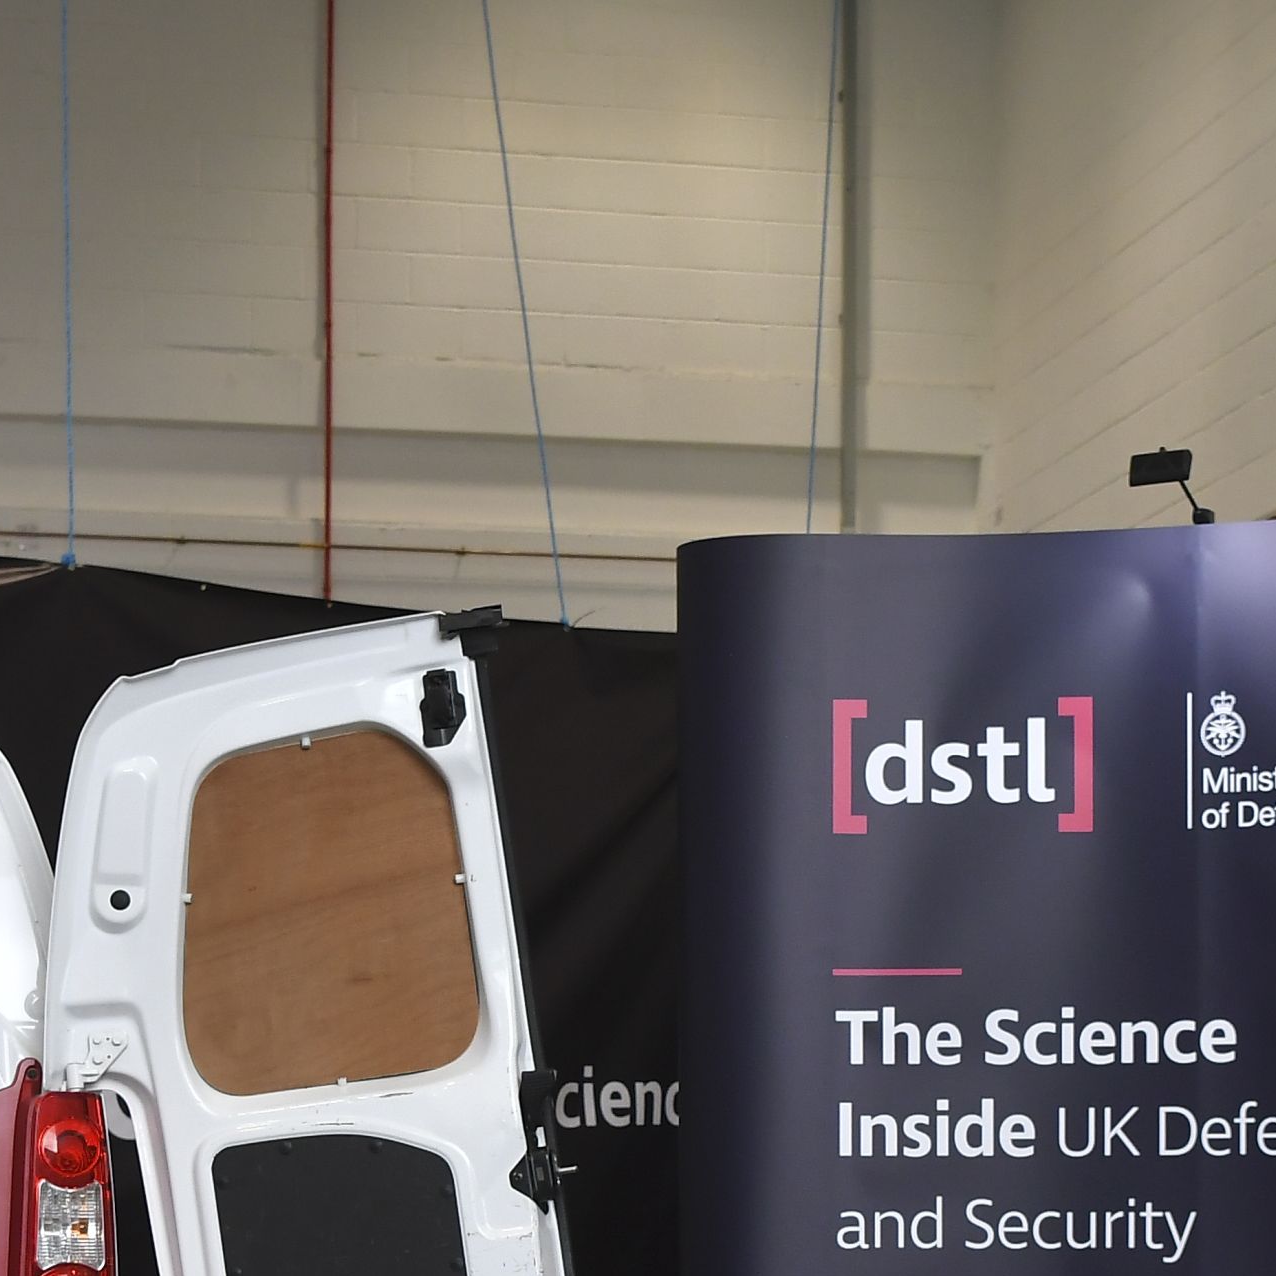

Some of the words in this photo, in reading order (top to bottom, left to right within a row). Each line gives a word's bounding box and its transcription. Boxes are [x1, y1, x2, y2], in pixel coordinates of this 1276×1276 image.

[1201, 801, 1231, 829] of
[835, 1006, 962, 1066] The
[984, 1006, 1238, 1066] Science
[838, 1098, 1036, 1158] Inside
[1058, 1106, 1141, 1158] UK
[836, 1195, 943, 1250] and
[964, 1197, 1197, 1264] Security
